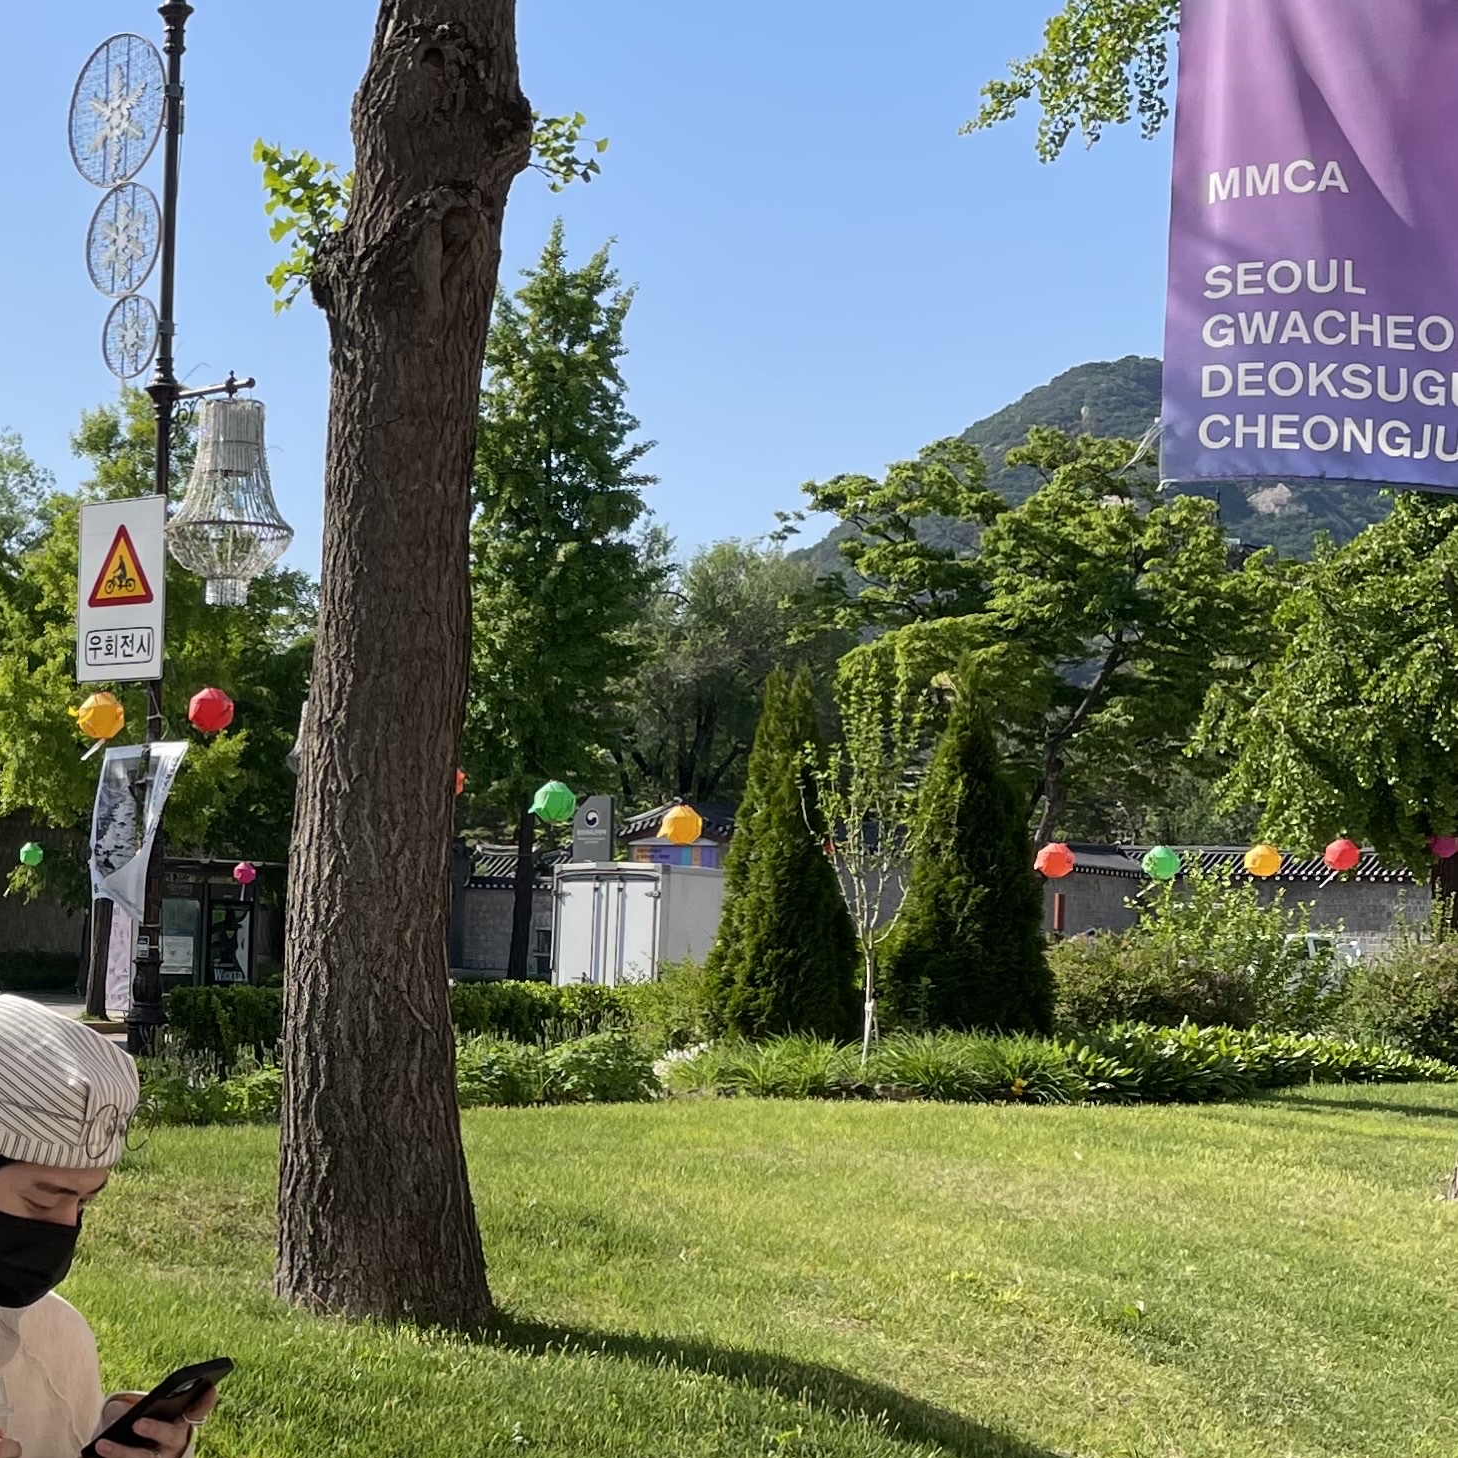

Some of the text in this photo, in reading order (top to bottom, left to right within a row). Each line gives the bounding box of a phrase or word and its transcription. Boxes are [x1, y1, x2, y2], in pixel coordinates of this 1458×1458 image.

[1208, 159, 1349, 204] MMCA
[1203, 259, 1366, 299] SEOUL
[1200, 361, 1458, 406] DEOKSUG
[1198, 413, 1458, 462] CHEONGJU
[88, 632, 151, 659] 우회전시
